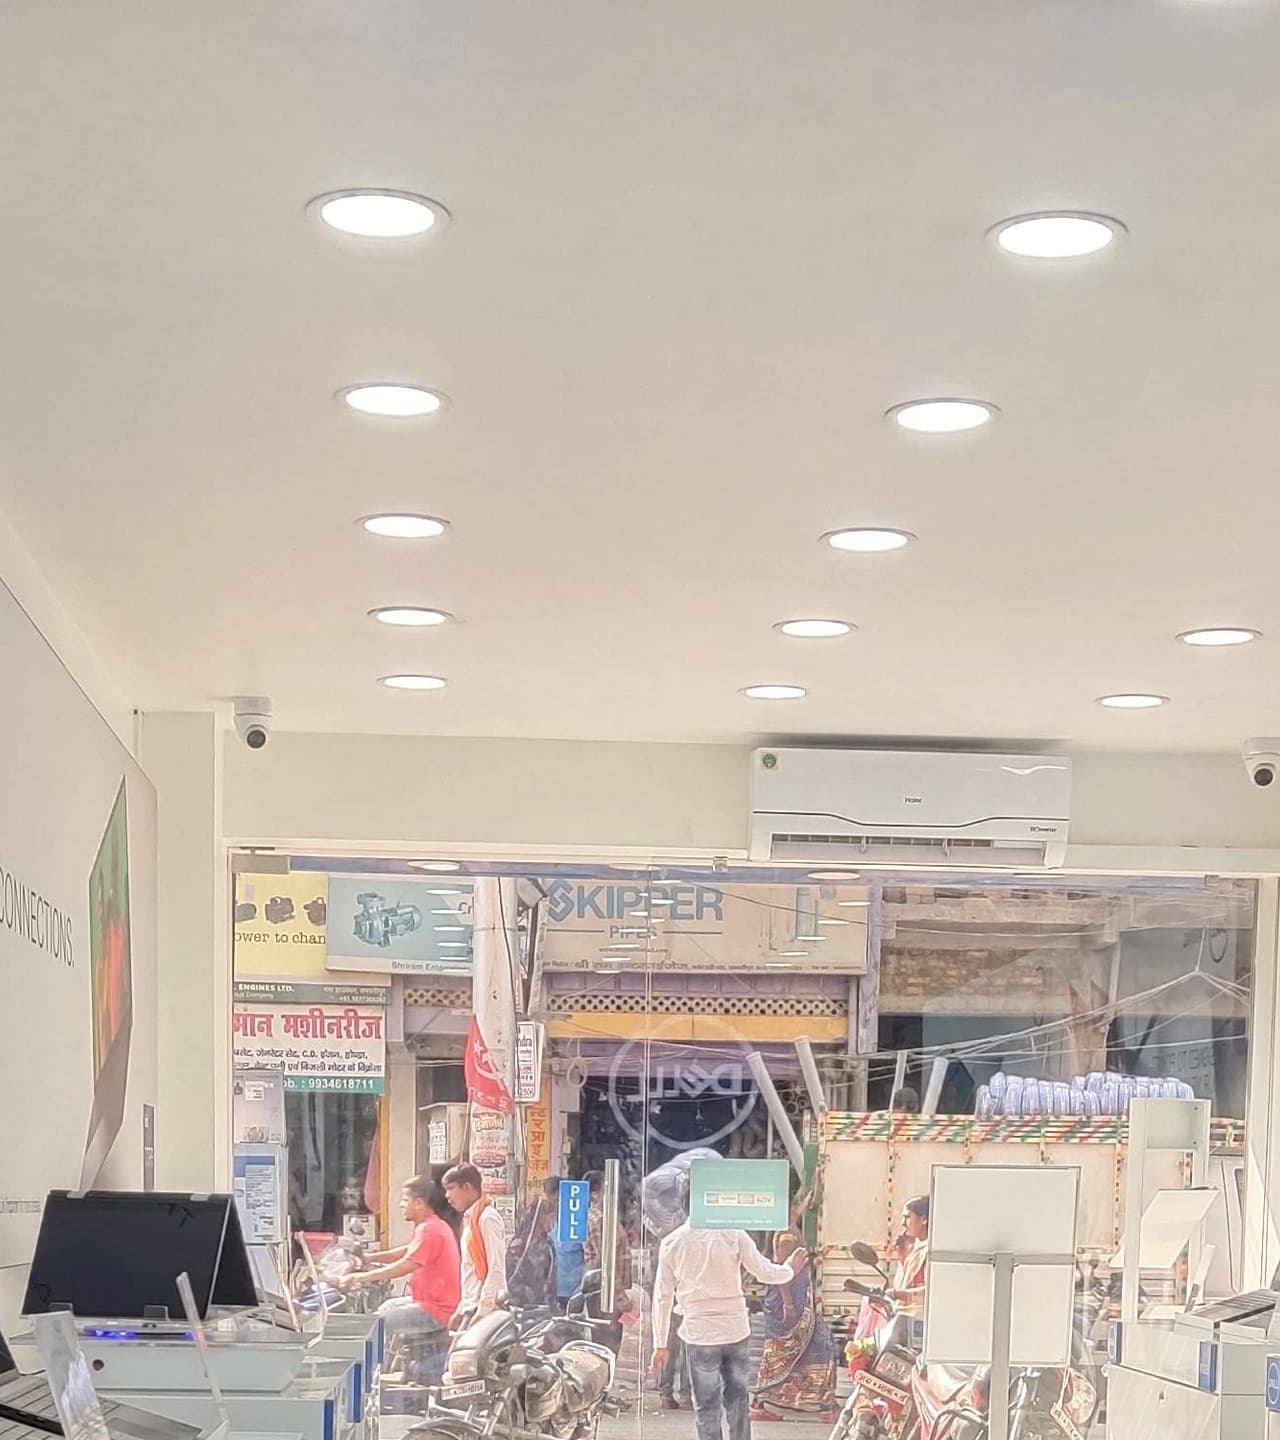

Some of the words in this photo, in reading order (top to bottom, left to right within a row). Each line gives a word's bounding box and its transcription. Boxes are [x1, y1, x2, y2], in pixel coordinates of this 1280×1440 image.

[547, 880, 723, 922] SKIPPER
[275, 932, 289, 944] to
[609, 925, 657, 939] PIPES
[238, 983, 275, 992] ENGINES
[276, 984, 294, 993] LTD.
[281, 1007, 382, 1039] मशीनरीज
[308, 1078, 374, 1089] 9934618711
[570, 1185, 581, 1240] PULL
